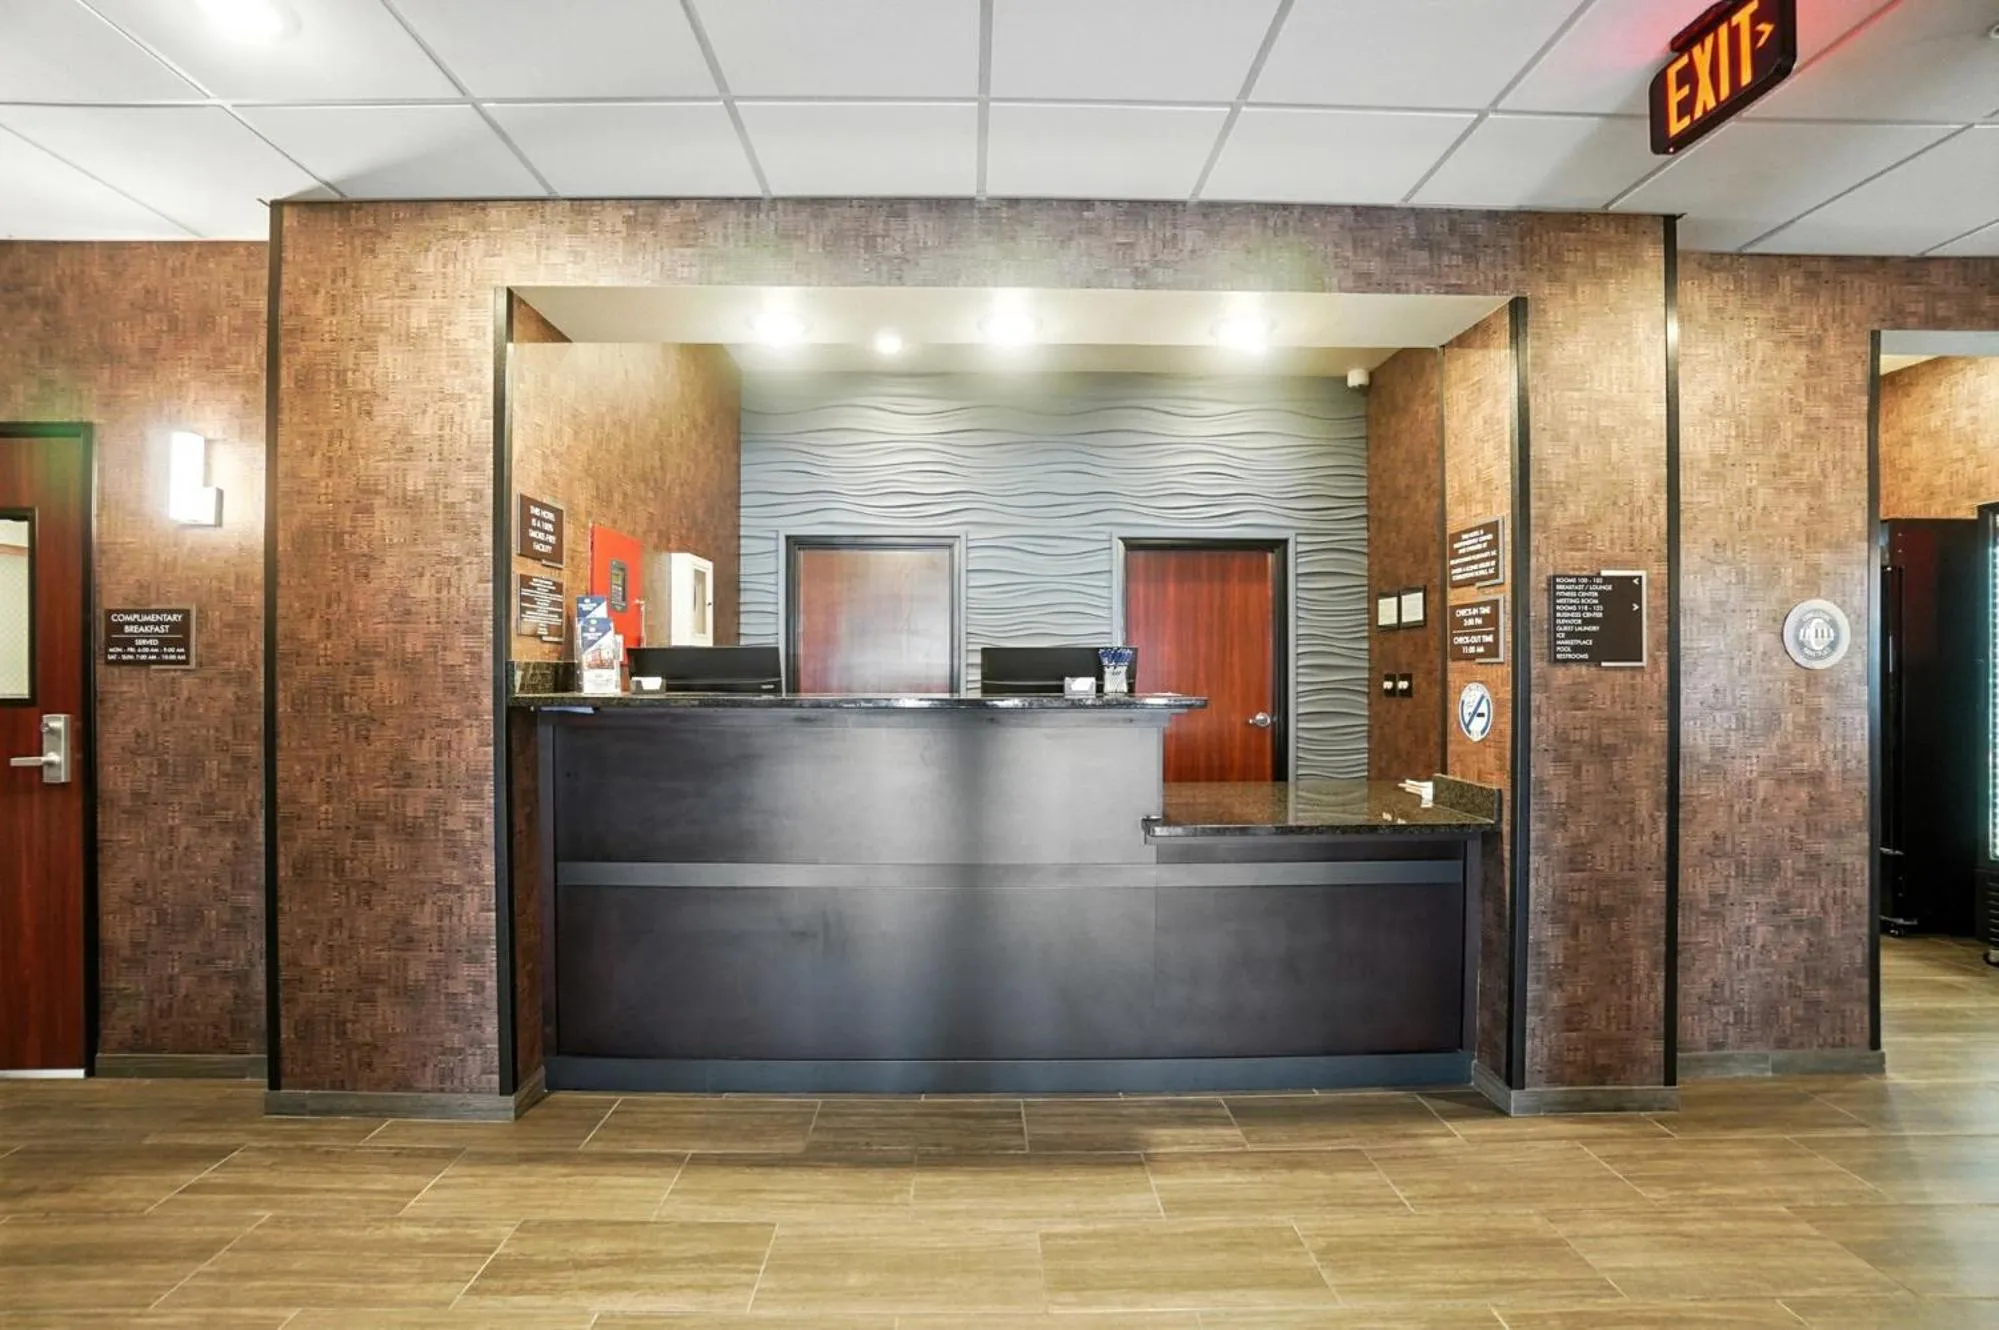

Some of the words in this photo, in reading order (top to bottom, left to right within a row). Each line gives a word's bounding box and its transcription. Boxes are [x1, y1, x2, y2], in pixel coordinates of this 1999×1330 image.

[1666, 0, 1759, 137] EXIT
[111, 614, 182, 622] COMPLIMENTARY
[1455, 607, 1478, 618] CHECK-IN
[124, 625, 170, 633] BREAKFAST
[1452, 634, 1480, 645] CHECK-OUT
